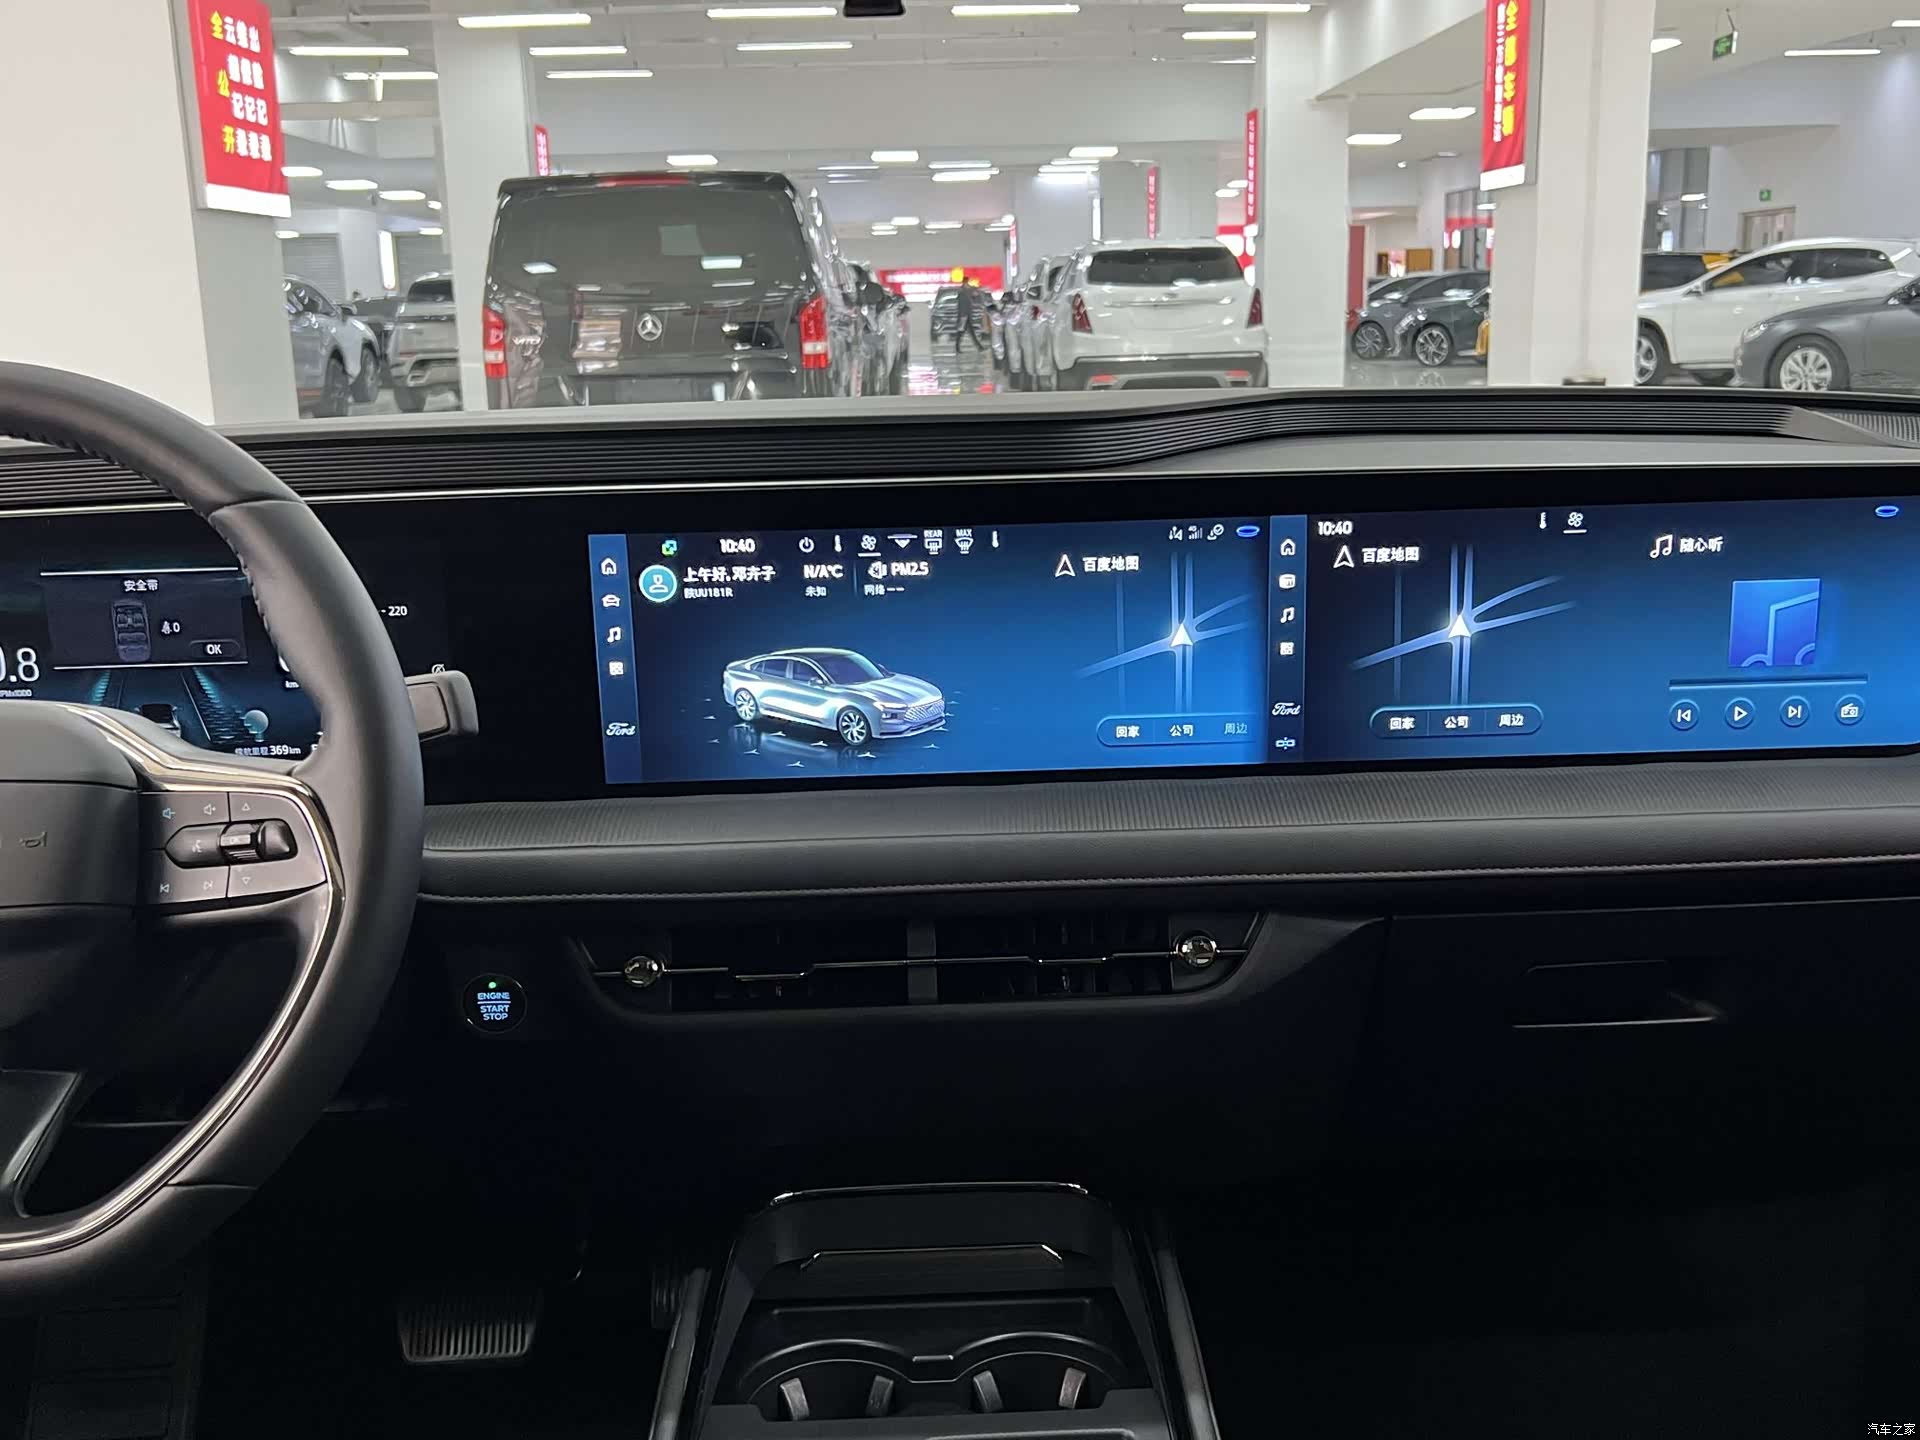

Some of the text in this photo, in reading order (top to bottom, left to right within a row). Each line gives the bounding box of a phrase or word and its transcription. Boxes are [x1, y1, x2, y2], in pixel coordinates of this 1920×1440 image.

[924, 529, 943, 538] REAR
[956, 529, 973, 537] MAX
[1318, 521, 1353, 536] 10:40
[720, 538, 755, 553] 10:40
[1680, 536, 1723, 553] 随心听
[1362, 547, 1419, 563] 百度地图
[890, 561, 929, 576] PM2.5
[1082, 555, 1139, 572] 百度地图
[124, 579, 158, 592] 安全带
[805, 586, 827, 597] 未知
[388, 606, 408, 616] 220
[206, 644, 222, 655] OK
[1272, 702, 1301, 716] Ford
[606, 722, 635, 736] Ford
[1390, 714, 1524, 730] 回家 公司 周边
[1116, 722, 1248, 738] 回家 公司 周边
[477, 992, 511, 1000] ENGINE
[480, 1005, 510, 1013] START
[483, 1013, 509, 1021] STOP
